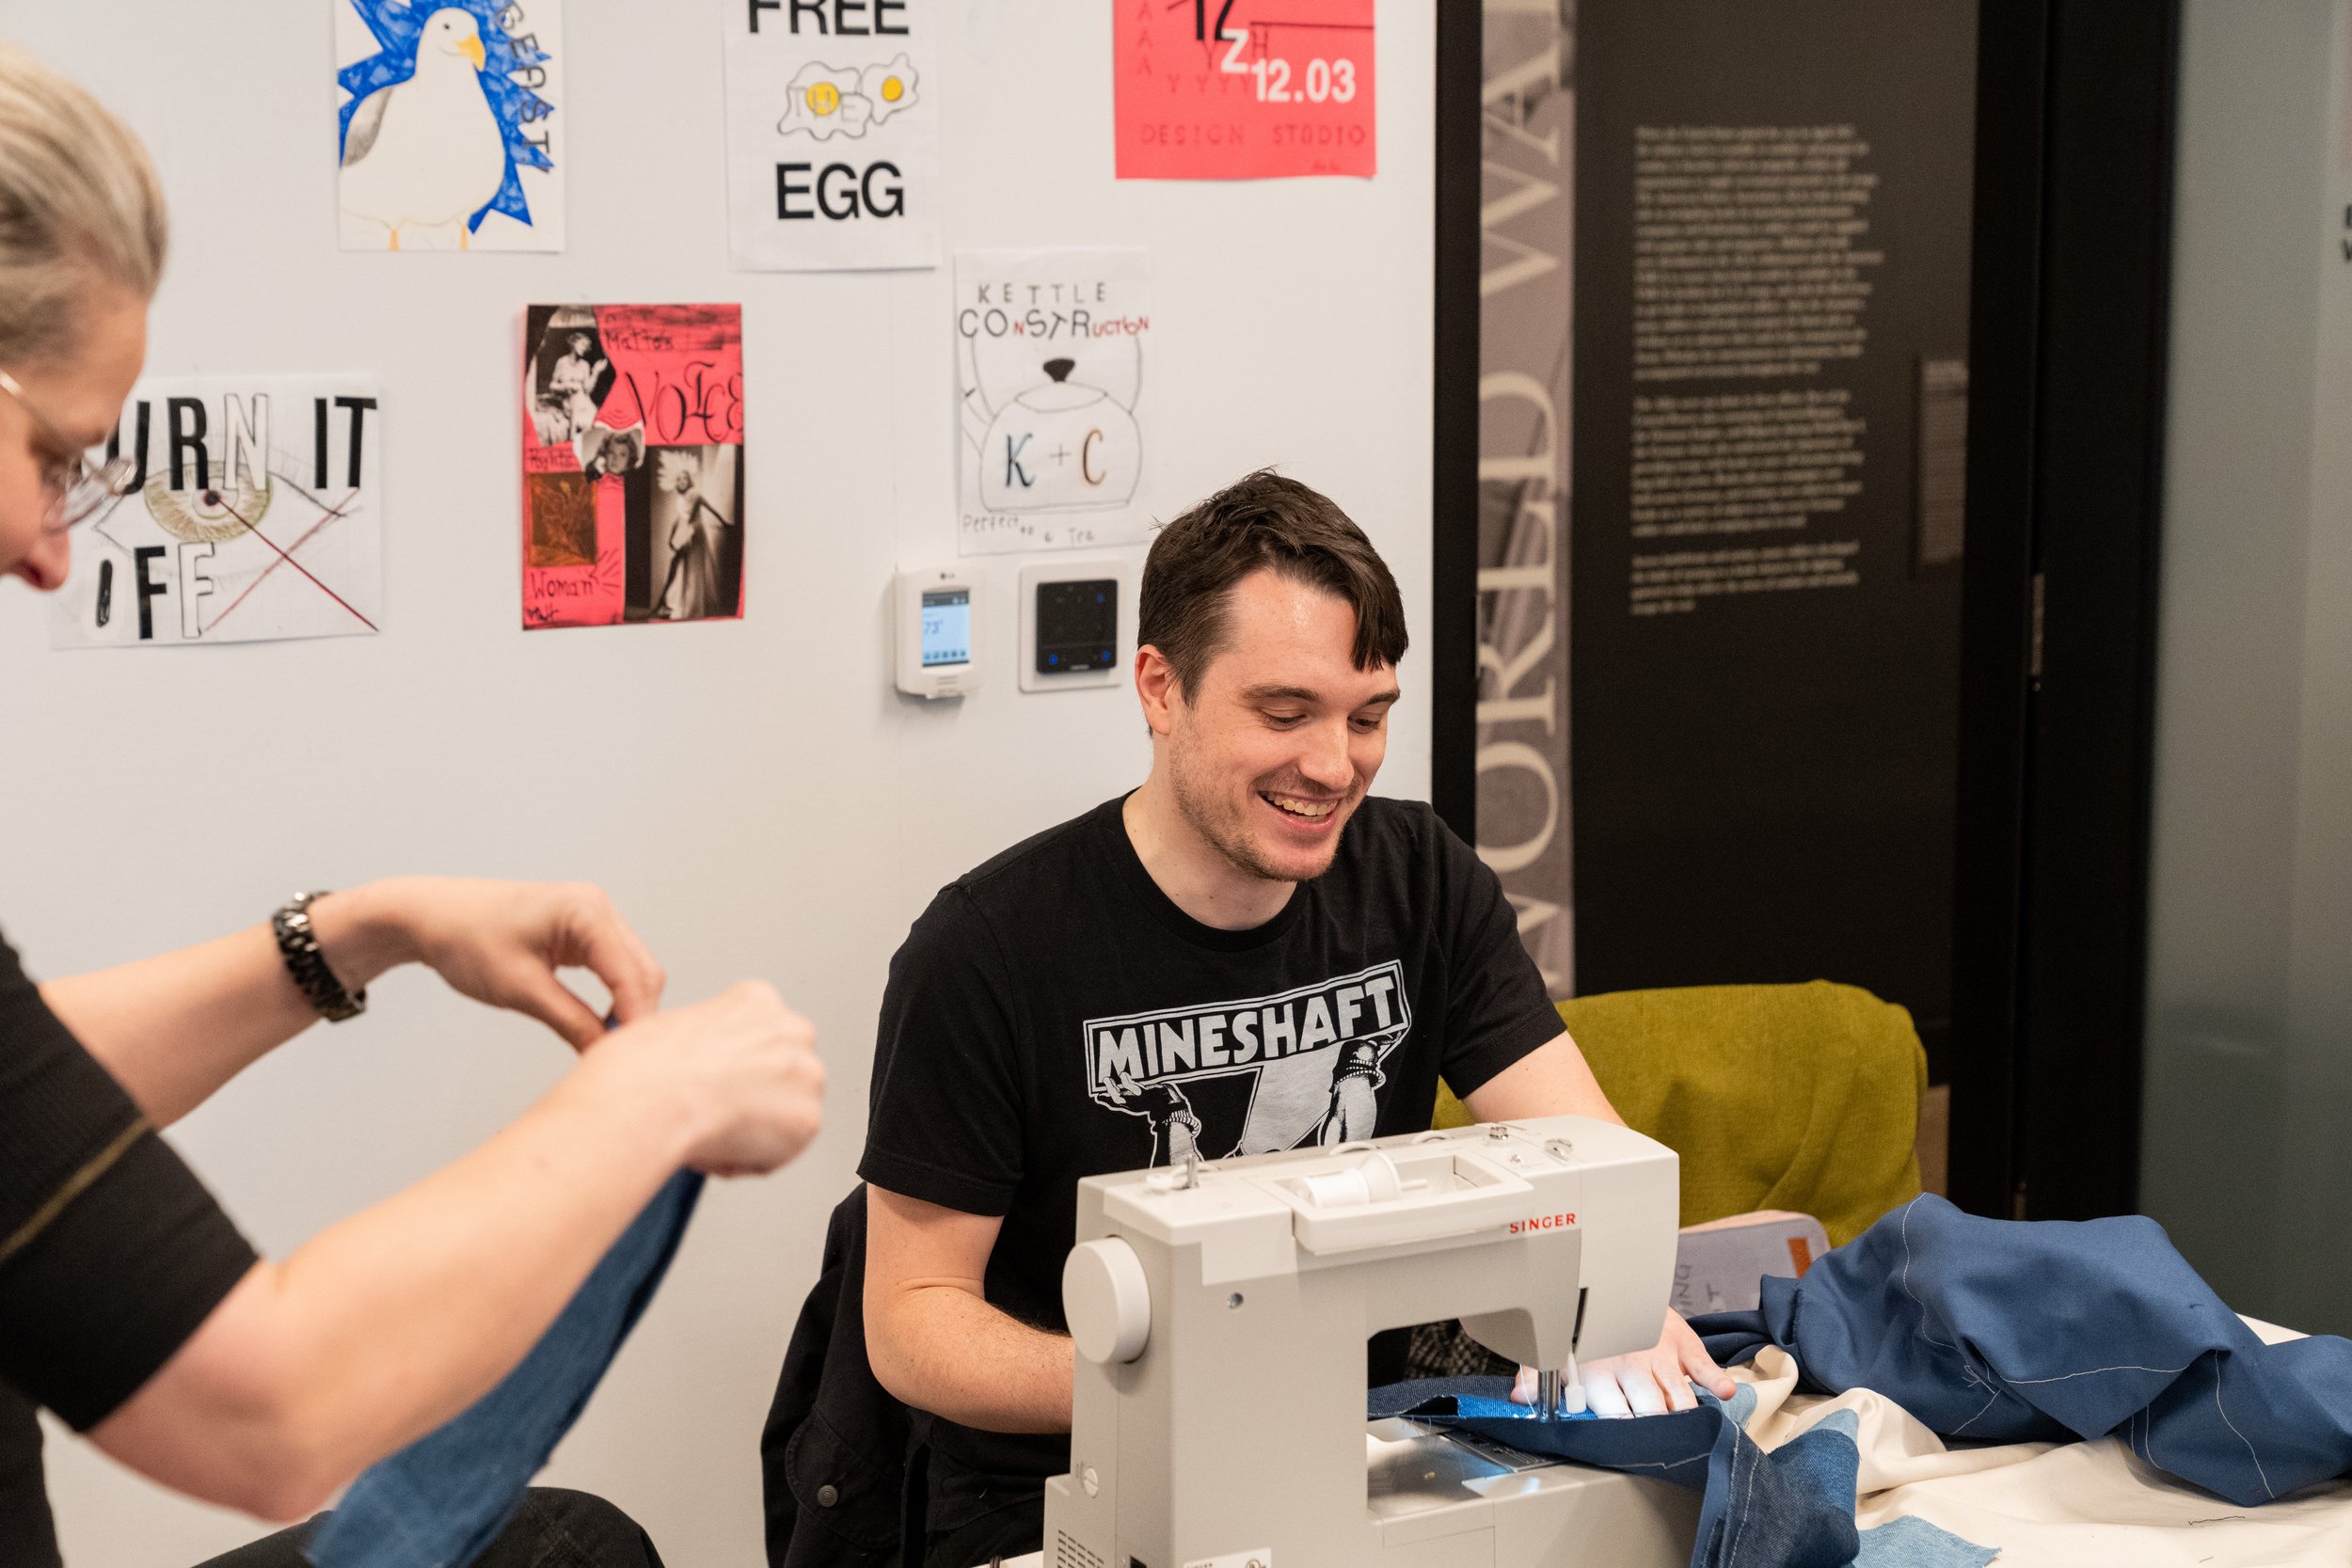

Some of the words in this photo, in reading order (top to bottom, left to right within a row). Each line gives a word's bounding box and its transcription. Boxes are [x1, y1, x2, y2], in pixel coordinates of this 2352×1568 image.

[1251, 57, 1356, 103] 12.03
[776, 161, 904, 220] EGG
[978, 282, 1107, 304] KETTLE
[314, 396, 378, 490] IT
[1005, 432, 1036, 488] K
[1084, 427, 1107, 486] C
[1097, 975, 1395, 1082] MINESHAFT
[1509, 1212, 1577, 1234] SINGER
